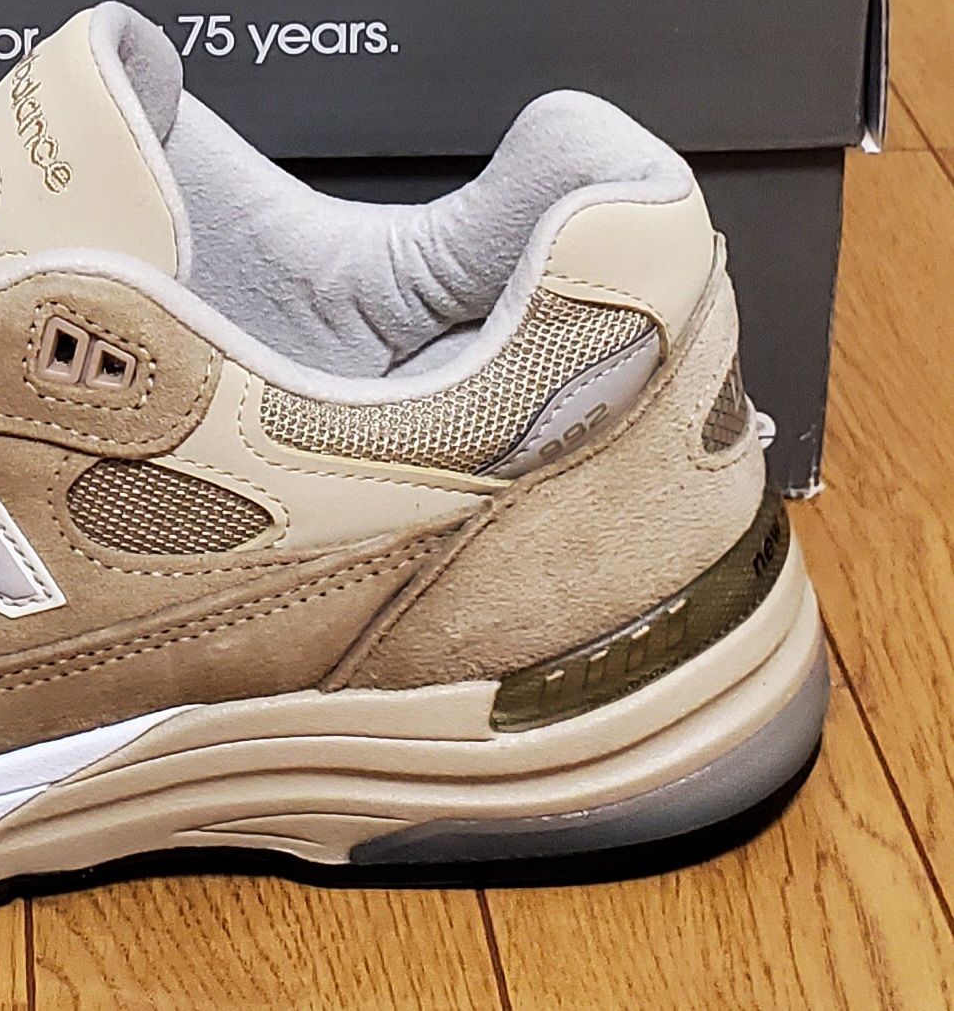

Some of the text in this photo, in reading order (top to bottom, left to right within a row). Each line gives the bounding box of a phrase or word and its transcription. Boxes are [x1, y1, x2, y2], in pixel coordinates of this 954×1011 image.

[177, 15, 235, 56] 75
[247, 21, 399, 65] years.
[538, 402, 609, 460] 992
